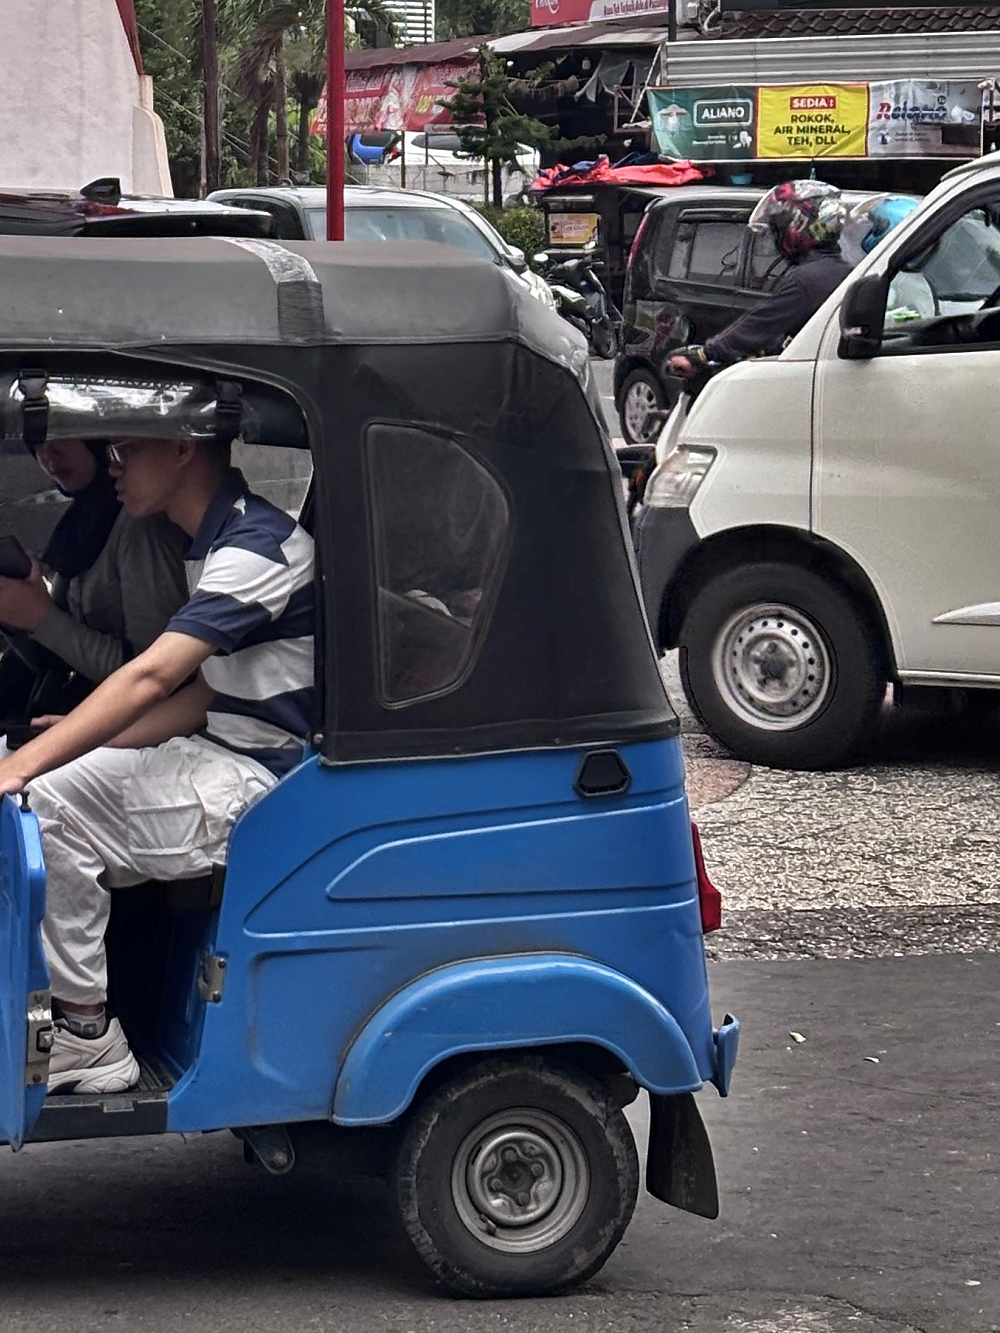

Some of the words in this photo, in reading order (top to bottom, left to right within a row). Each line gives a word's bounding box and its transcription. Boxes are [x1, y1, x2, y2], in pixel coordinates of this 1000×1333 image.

[702, 107, 745, 119] ALIANO
[791, 114, 835, 124] ROKOK,
[774, 126, 793, 135] AIR
[797, 125, 851, 135] MINERAL,
[787, 136, 813, 147] TEH,
[815, 136, 837, 145] DLL
